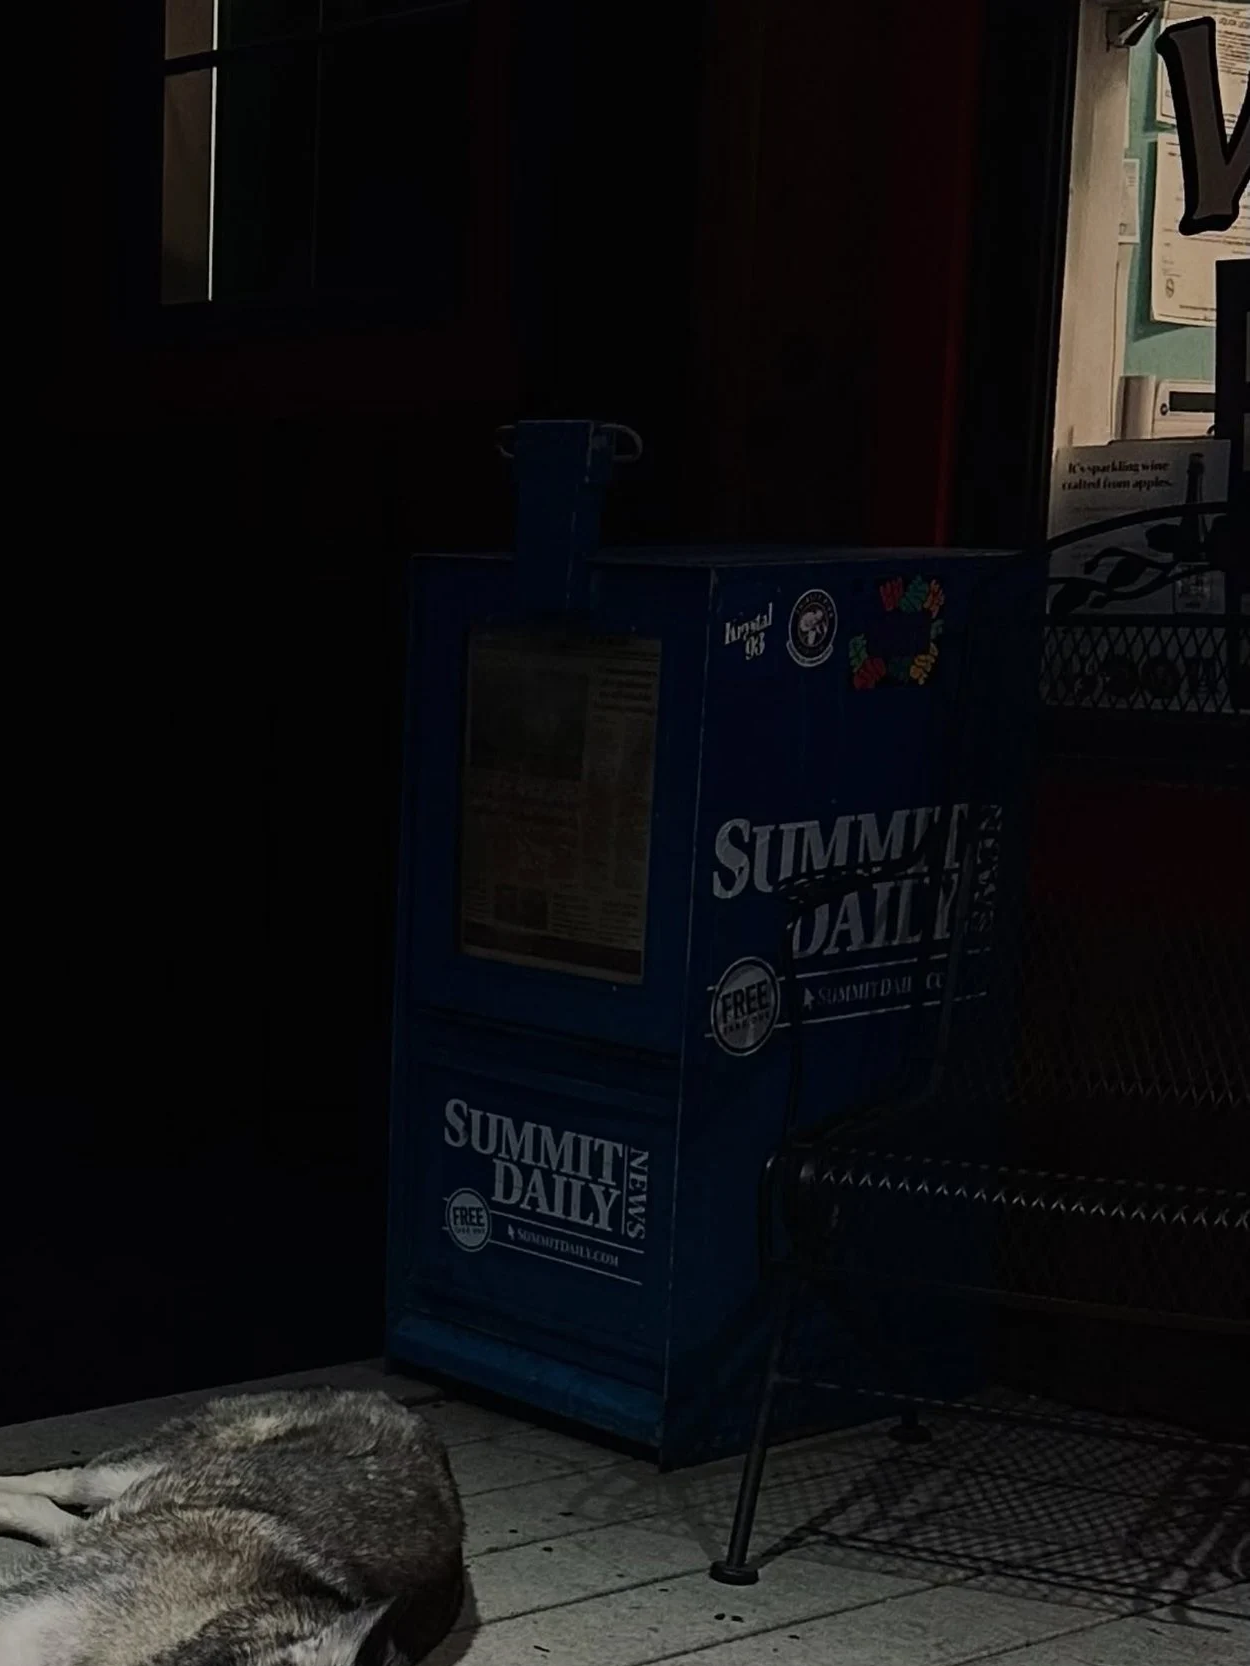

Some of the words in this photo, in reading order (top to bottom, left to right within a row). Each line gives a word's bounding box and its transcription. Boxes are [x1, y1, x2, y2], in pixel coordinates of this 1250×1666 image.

[1061, 477, 1101, 490] crafted
[1103, 476, 1130, 489] from
[1087, 460, 1140, 476] sparkling
[1141, 460, 1170, 472] wine
[722, 978, 769, 1023] FREE
[443, 1097, 623, 1188] SUMMIT
[490, 1157, 622, 1233] DAILY
[625, 1146, 649, 1241] NEWS
[452, 1206, 486, 1228] FREE
